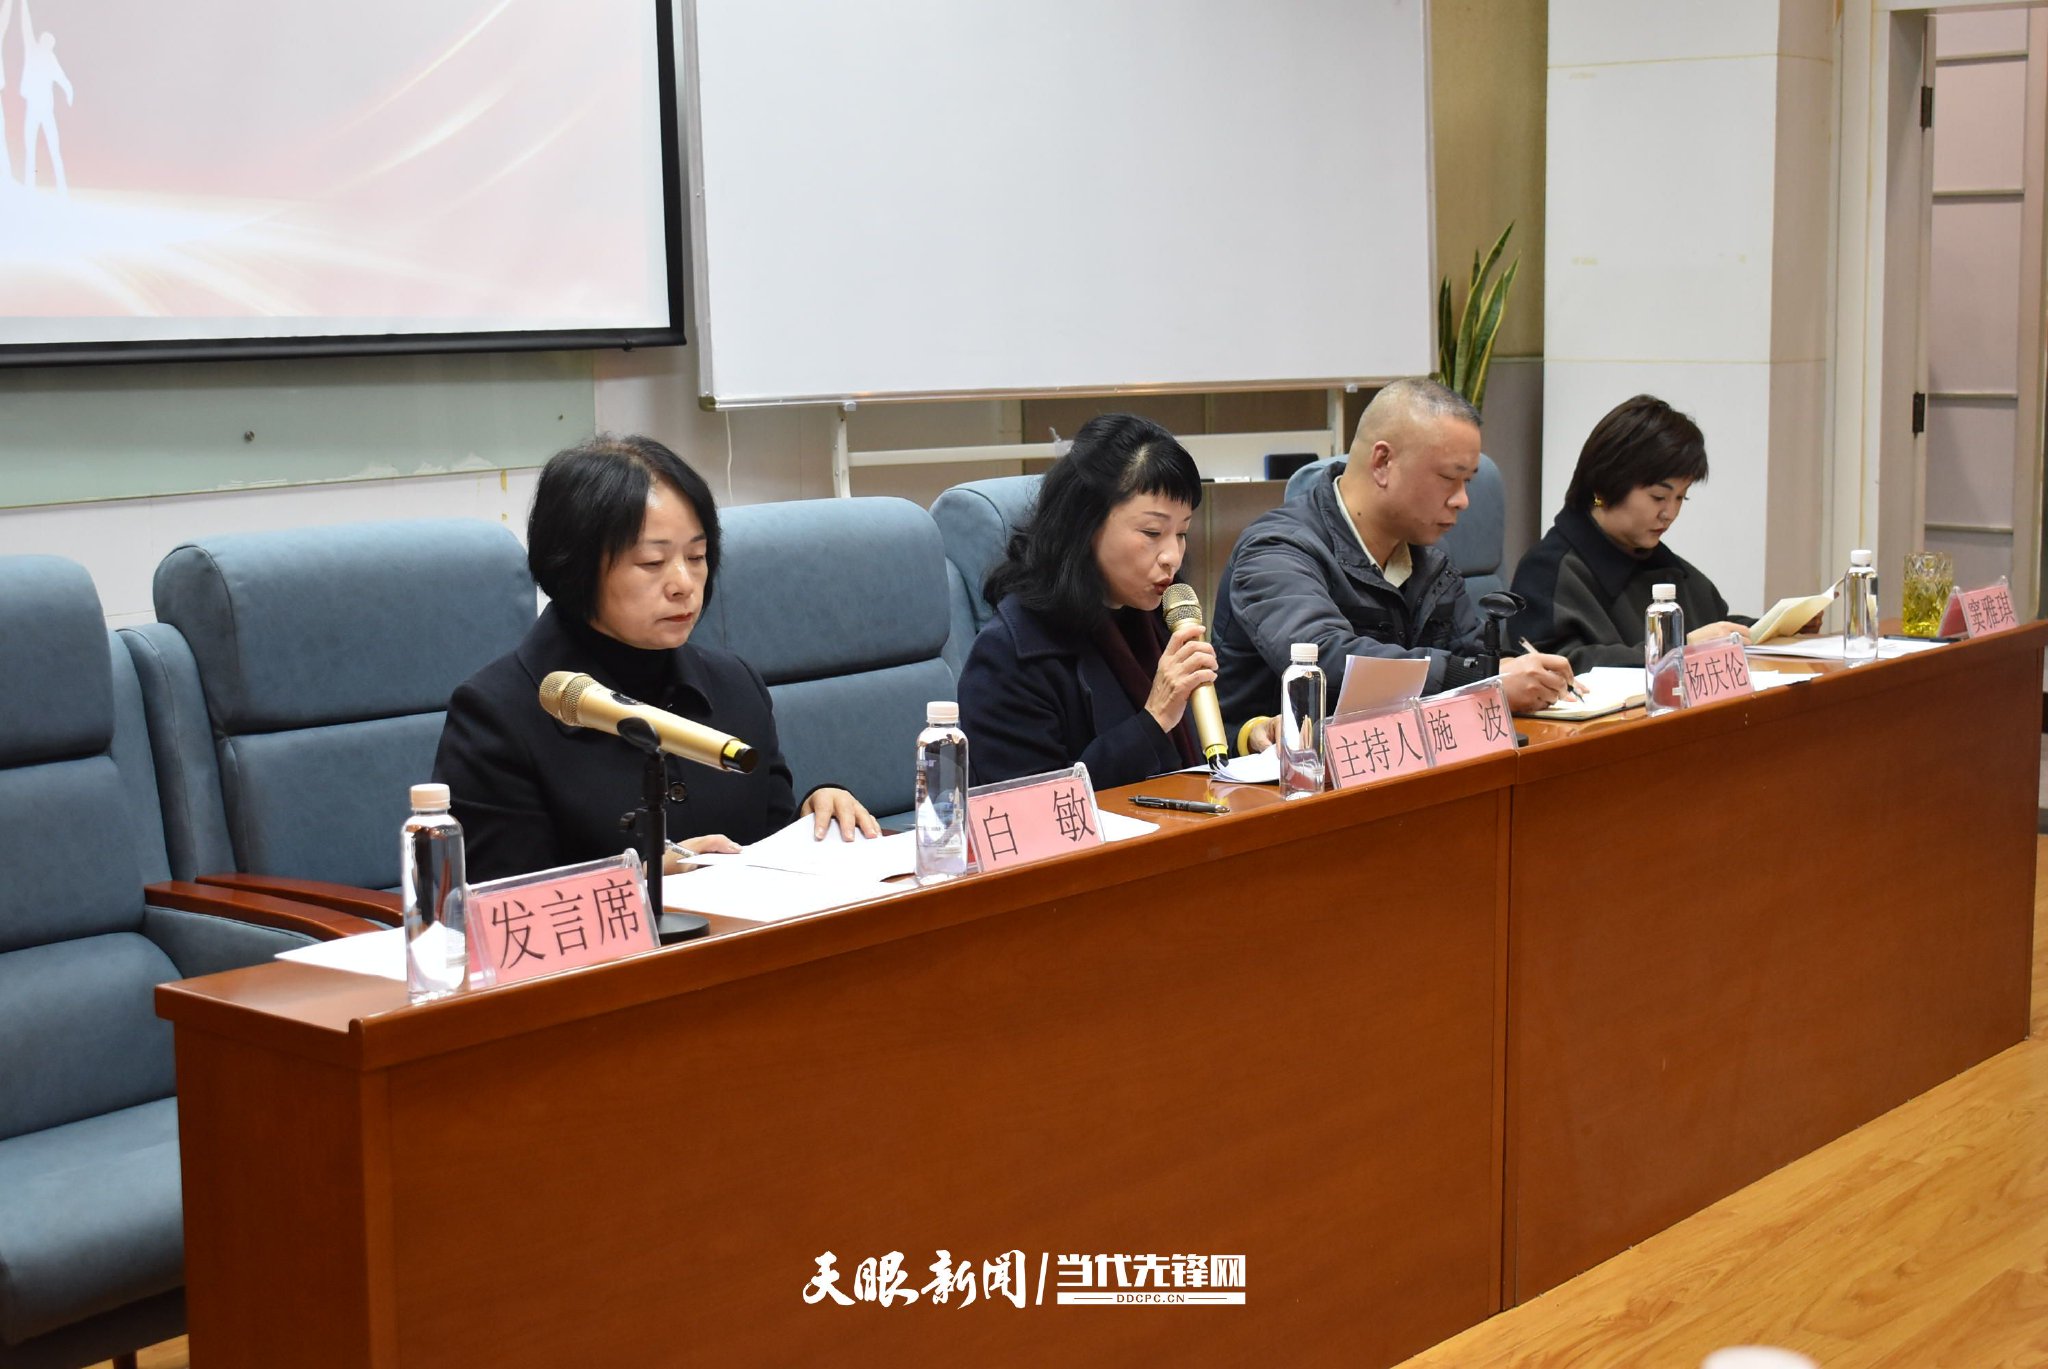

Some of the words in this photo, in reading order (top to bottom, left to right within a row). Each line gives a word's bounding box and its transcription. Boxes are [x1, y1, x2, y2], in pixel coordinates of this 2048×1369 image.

[1967, 592, 2015, 633] 窦雅琪
[1685, 651, 1748, 700] 杨庆伦
[1335, 721, 1424, 780] 主持人
[490, 878, 640, 970] 发言席
